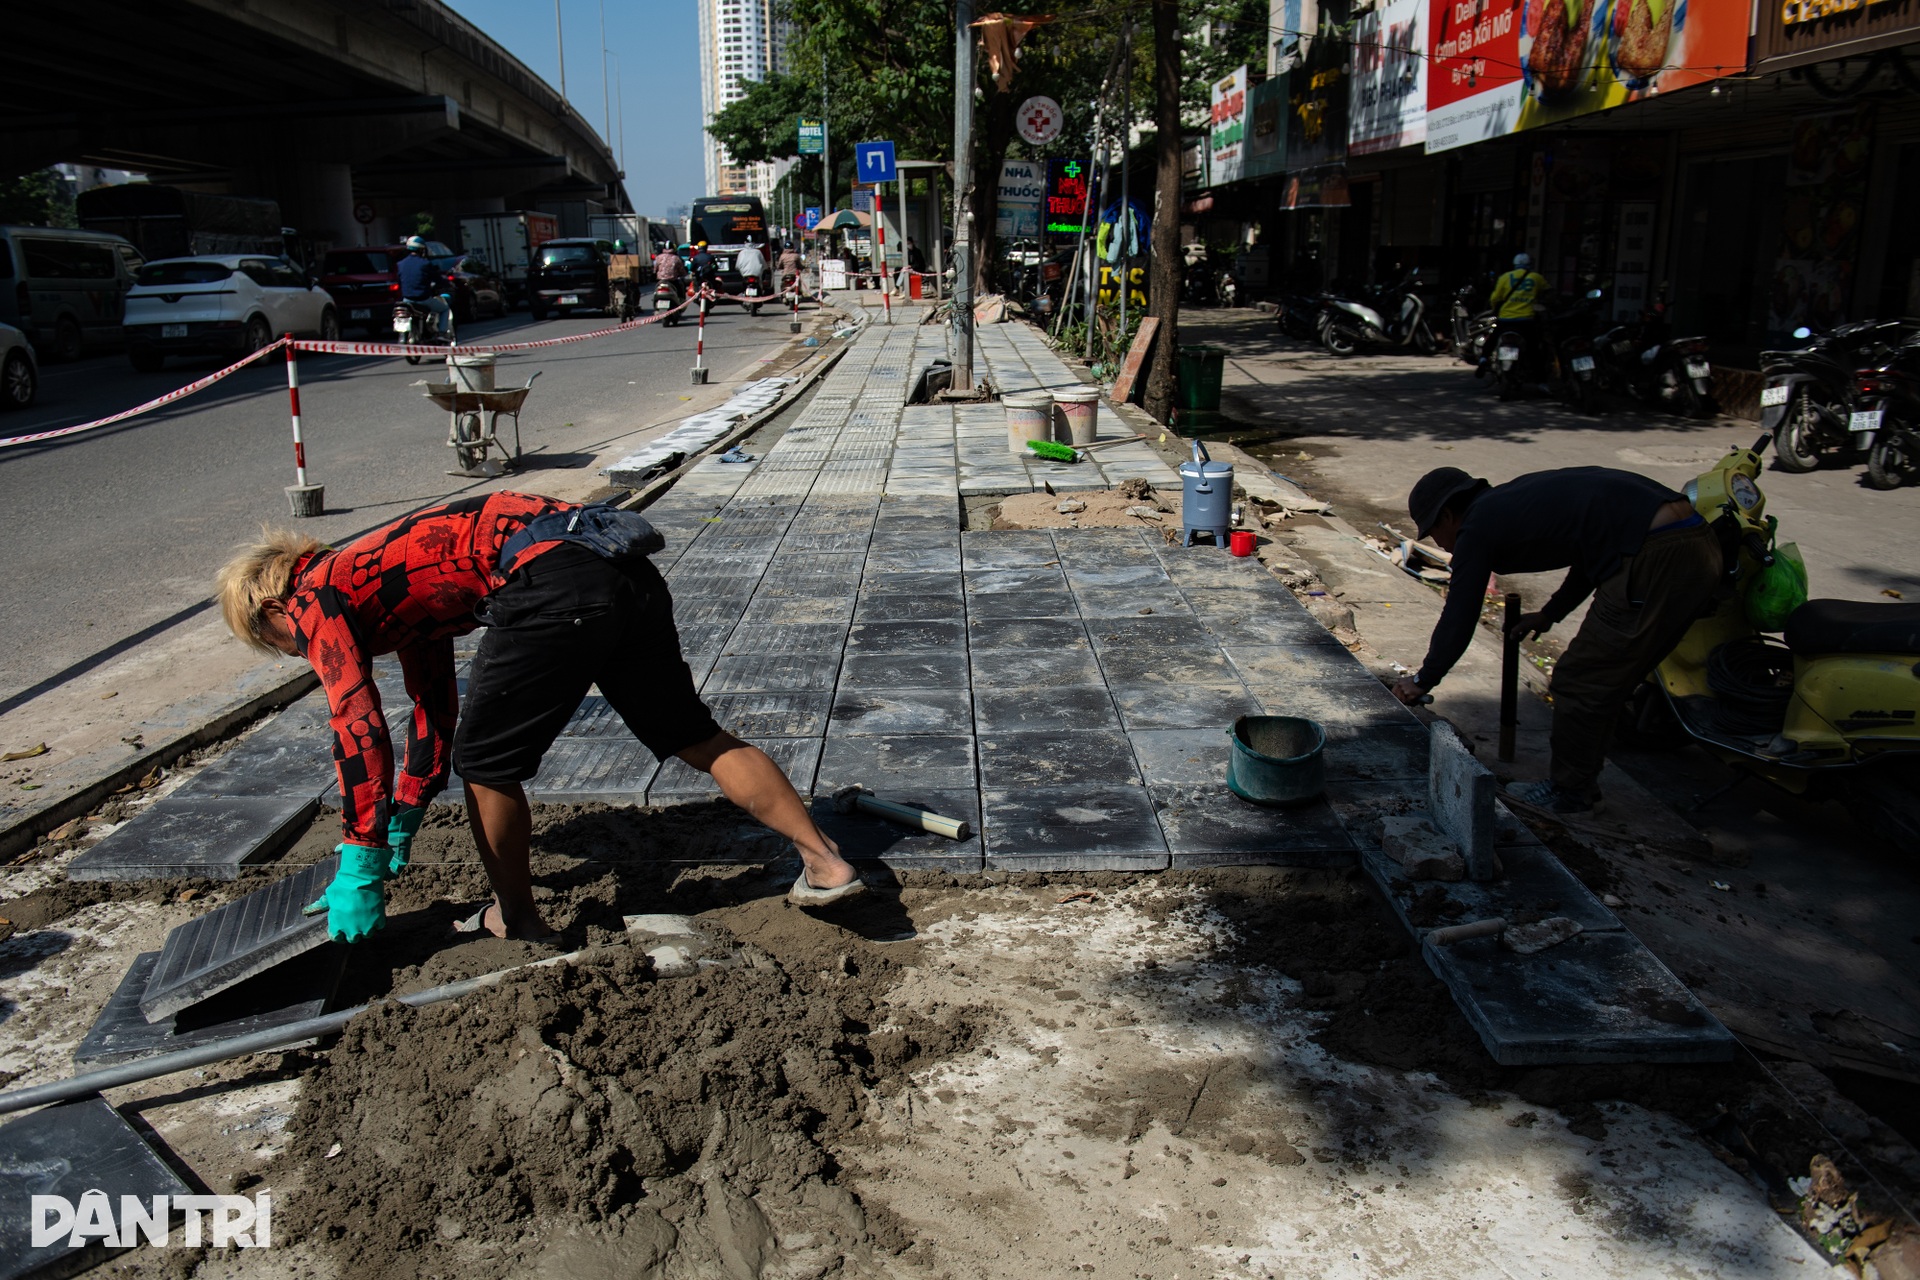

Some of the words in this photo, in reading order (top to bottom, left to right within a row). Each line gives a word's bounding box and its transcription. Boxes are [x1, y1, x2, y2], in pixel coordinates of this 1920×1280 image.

[1458, 30, 1472, 53] Gà
[799, 127, 822, 136] HOTEL
[1005, 166, 1032, 178] NHÀ
[997, 183, 1040, 198] THUỐC
[1058, 174, 1086, 194] NHÀ
[1510, 273, 1535, 292] be
